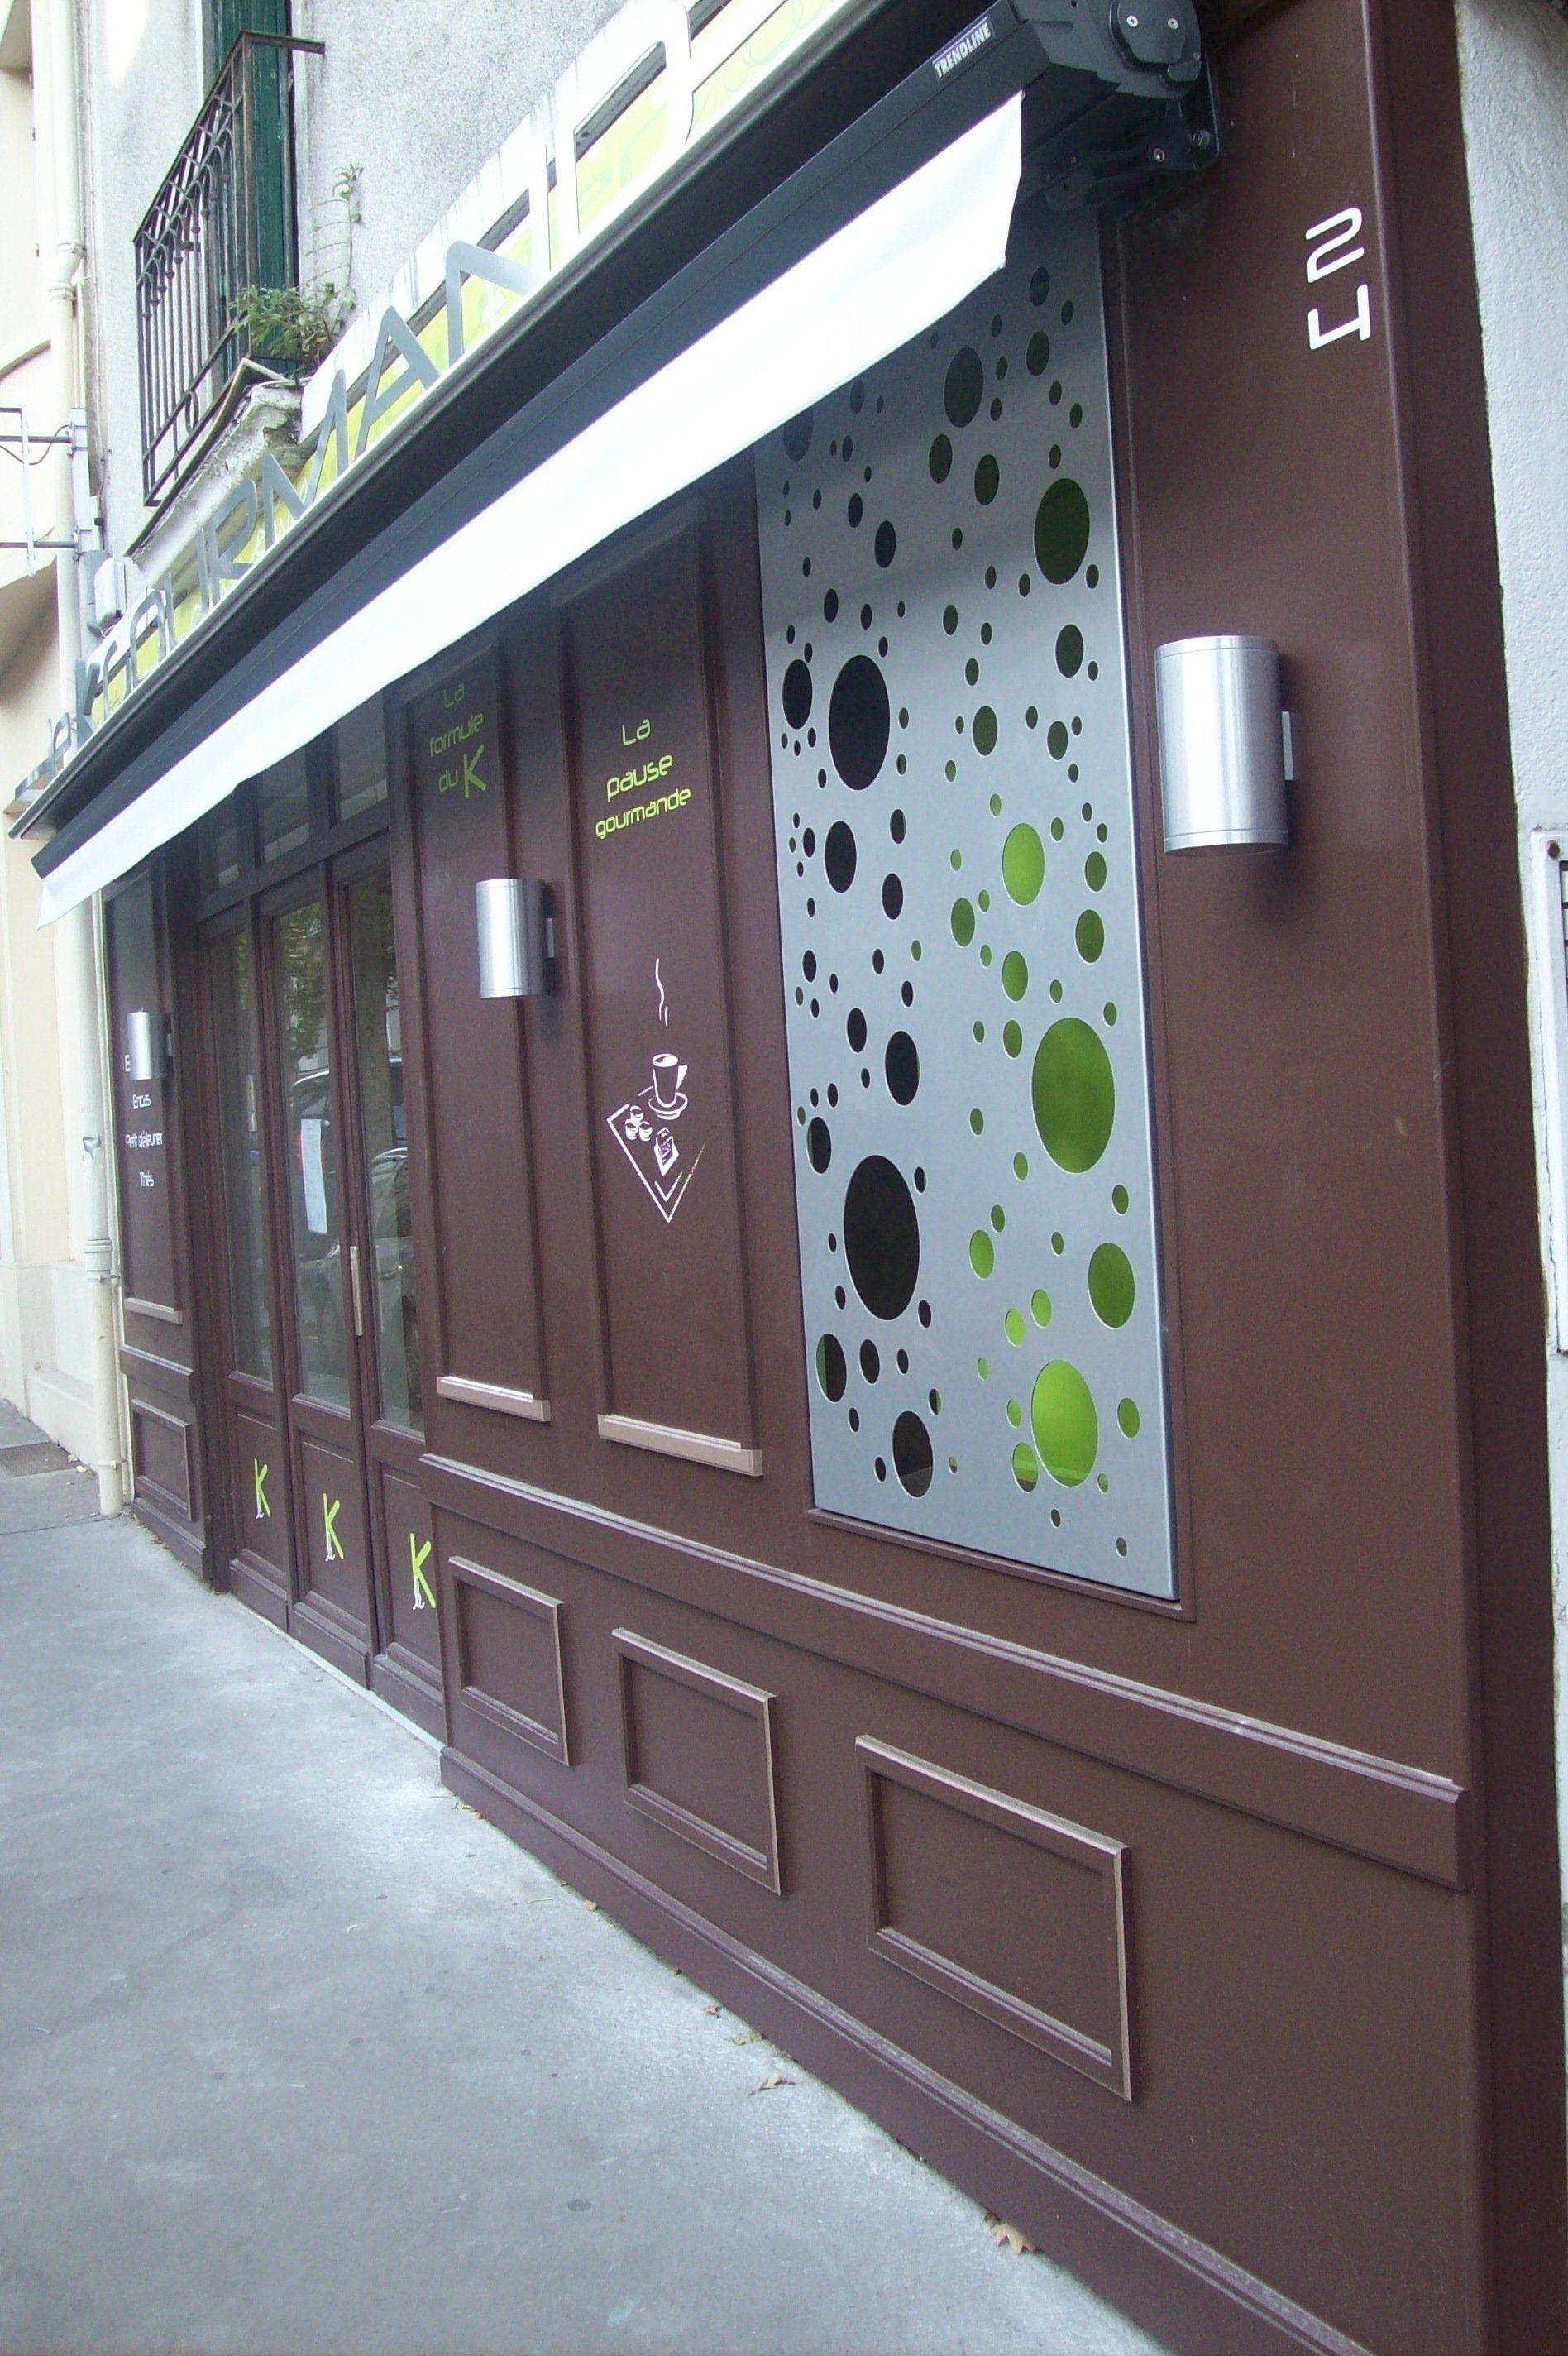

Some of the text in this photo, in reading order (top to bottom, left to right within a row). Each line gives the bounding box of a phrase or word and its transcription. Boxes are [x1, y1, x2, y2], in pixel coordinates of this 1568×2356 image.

[934, 22, 991, 78] TRENDLINE
[1305, 207, 1371, 350] 42
[443, 682, 465, 708] La
[429, 712, 484, 758] formule
[622, 718, 651, 746] La
[438, 744, 486, 798] du K
[606, 754, 673, 802] pause
[595, 787, 691, 840] gourmande
